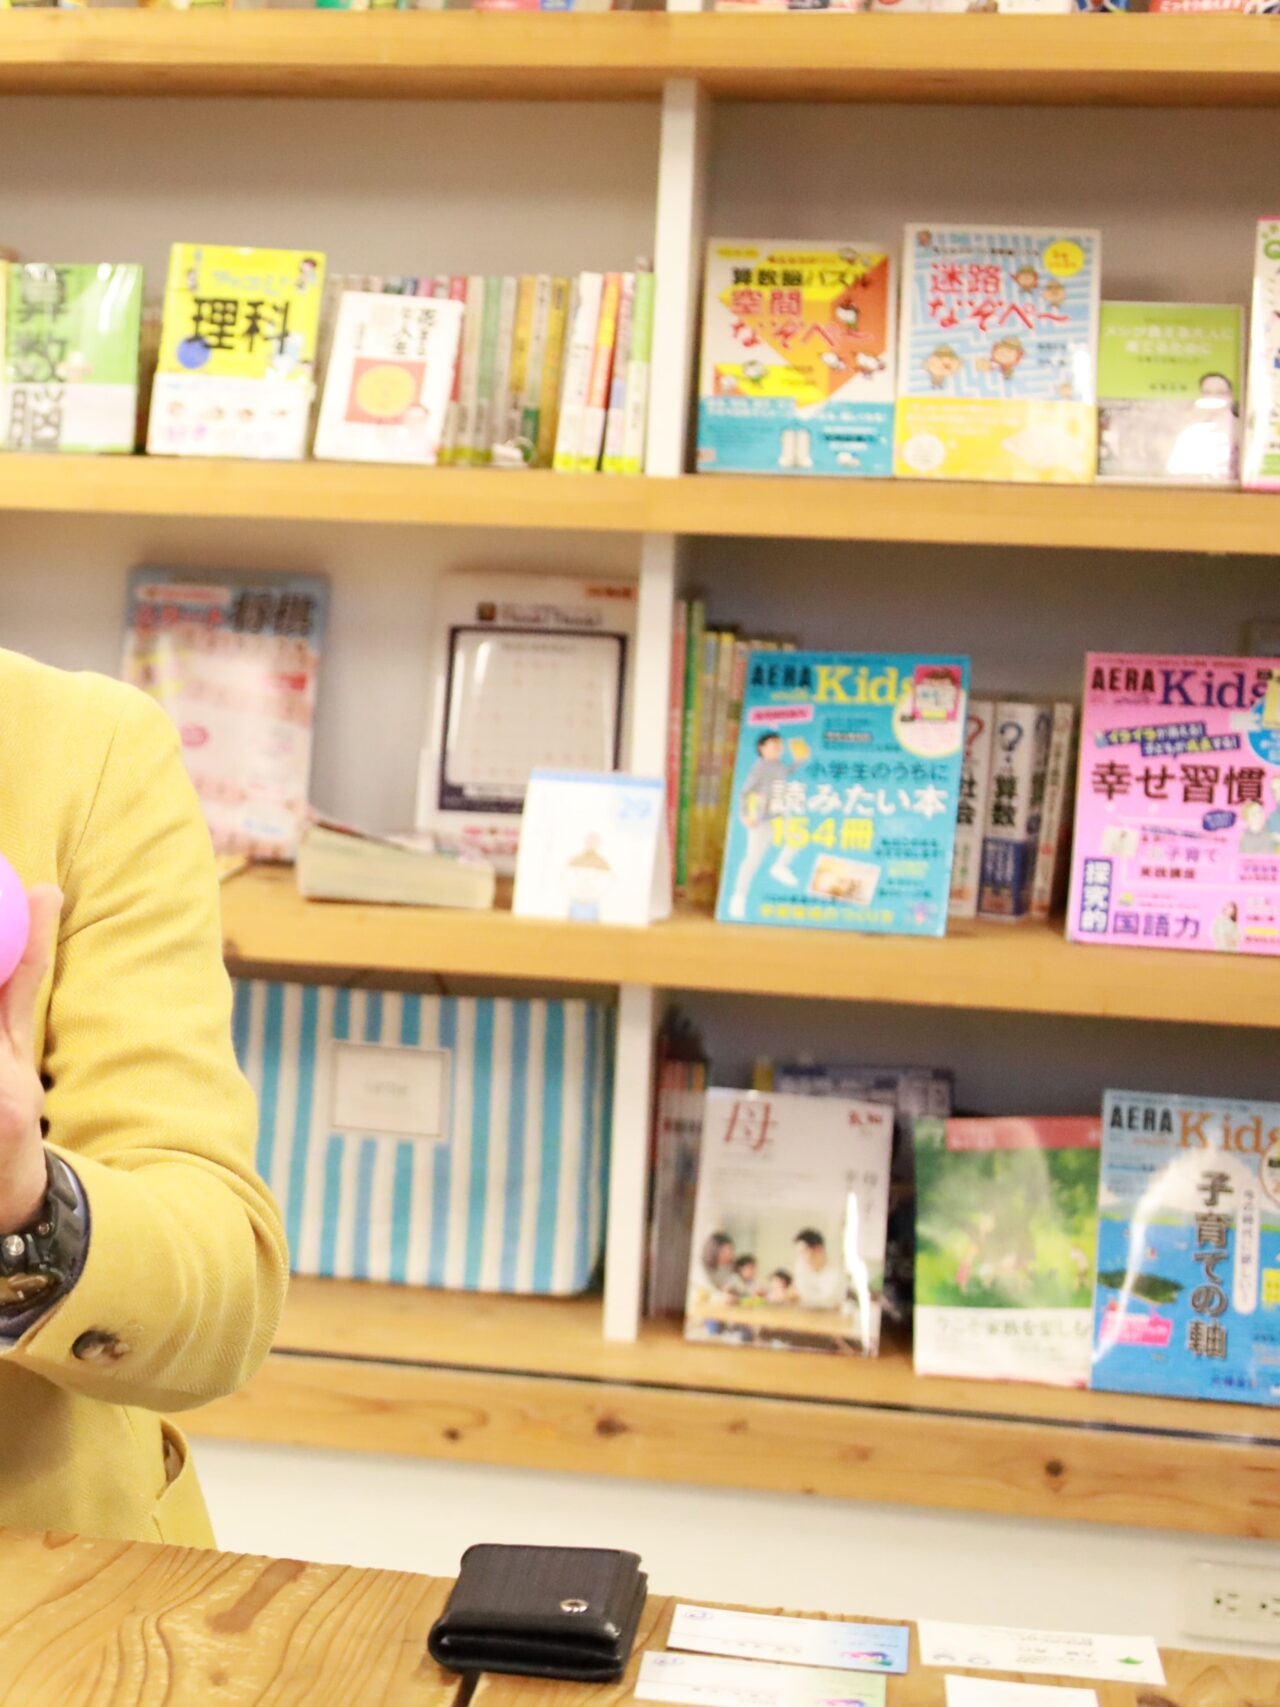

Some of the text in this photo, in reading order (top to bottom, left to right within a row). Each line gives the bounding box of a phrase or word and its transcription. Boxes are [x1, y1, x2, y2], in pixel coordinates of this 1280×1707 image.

[930, 261, 1001, 295] 迷路
[731, 288, 804, 316] 空間
[187, 297, 290, 355] 理科
[750, 664, 812, 688] AERA
[1090, 667, 1156, 693] AERA
[805, 758, 950, 783] 小学生のうちに
[1091, 761, 1267, 806] 幸せ習慣
[769, 781, 950, 819] 読みたい本
[770, 816, 874, 851] 154冊
[1112, 910, 1201, 940] 国語力
[723, 1101, 776, 1152] 母
[1109, 1104, 1174, 1135] AERA
[1187, 1169, 1234, 1361] 子育ての軸
